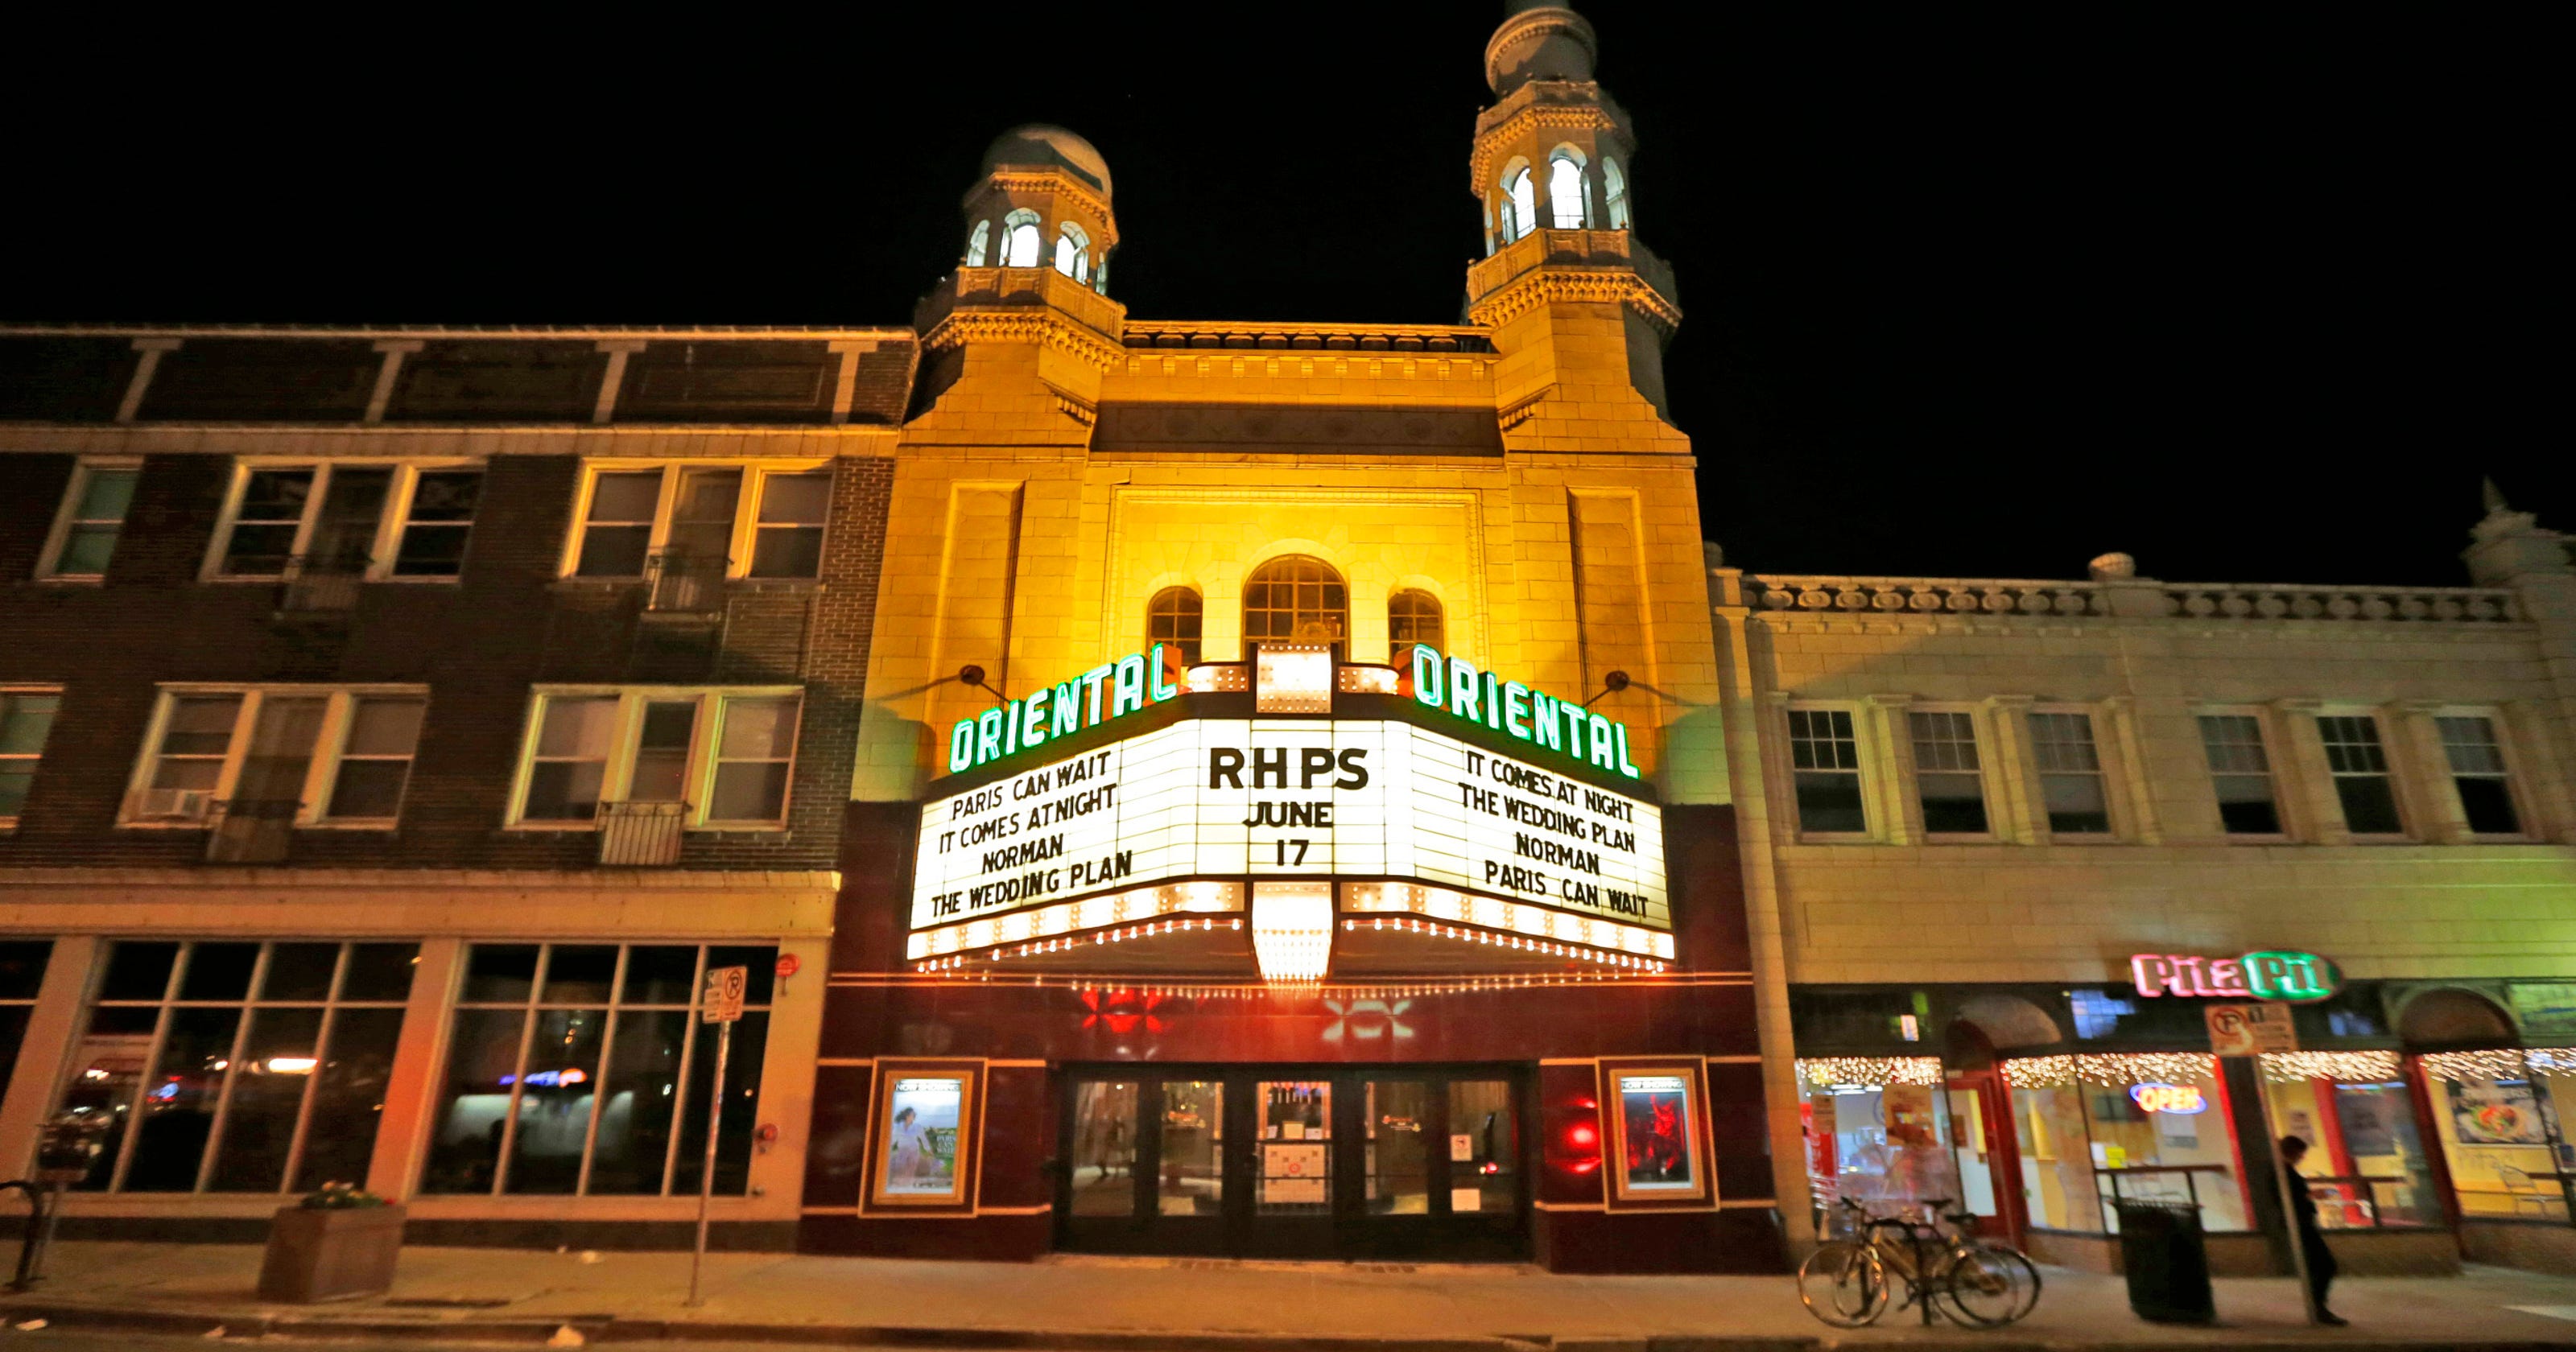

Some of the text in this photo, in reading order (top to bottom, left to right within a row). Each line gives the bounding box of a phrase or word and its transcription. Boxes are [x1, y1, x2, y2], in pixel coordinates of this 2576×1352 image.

[949, 643, 1177, 773] ORIENTAL
[1412, 644, 1639, 779] ORIENTAL
[952, 751, 1110, 820] PARIS CAN WAIT
[1210, 747, 1368, 790] RHPS
[1468, 750, 1633, 822] IT COMES AT NIGHT
[939, 783, 1117, 854] IT COMES AT NIGHT
[1242, 802, 1334, 828] JUNE
[1458, 782, 1636, 853] THE WEDDING PLAN
[931, 850, 1133, 917] THE WEDDING PLAN
[982, 833, 1063, 874] NORMAN
[1277, 839, 1310, 867] 17
[1516, 831, 1600, 876] NORMAN
[1485, 859, 1649, 917] PARIS CAN WAIT
[2137, 1086, 2201, 1112] OPEN
